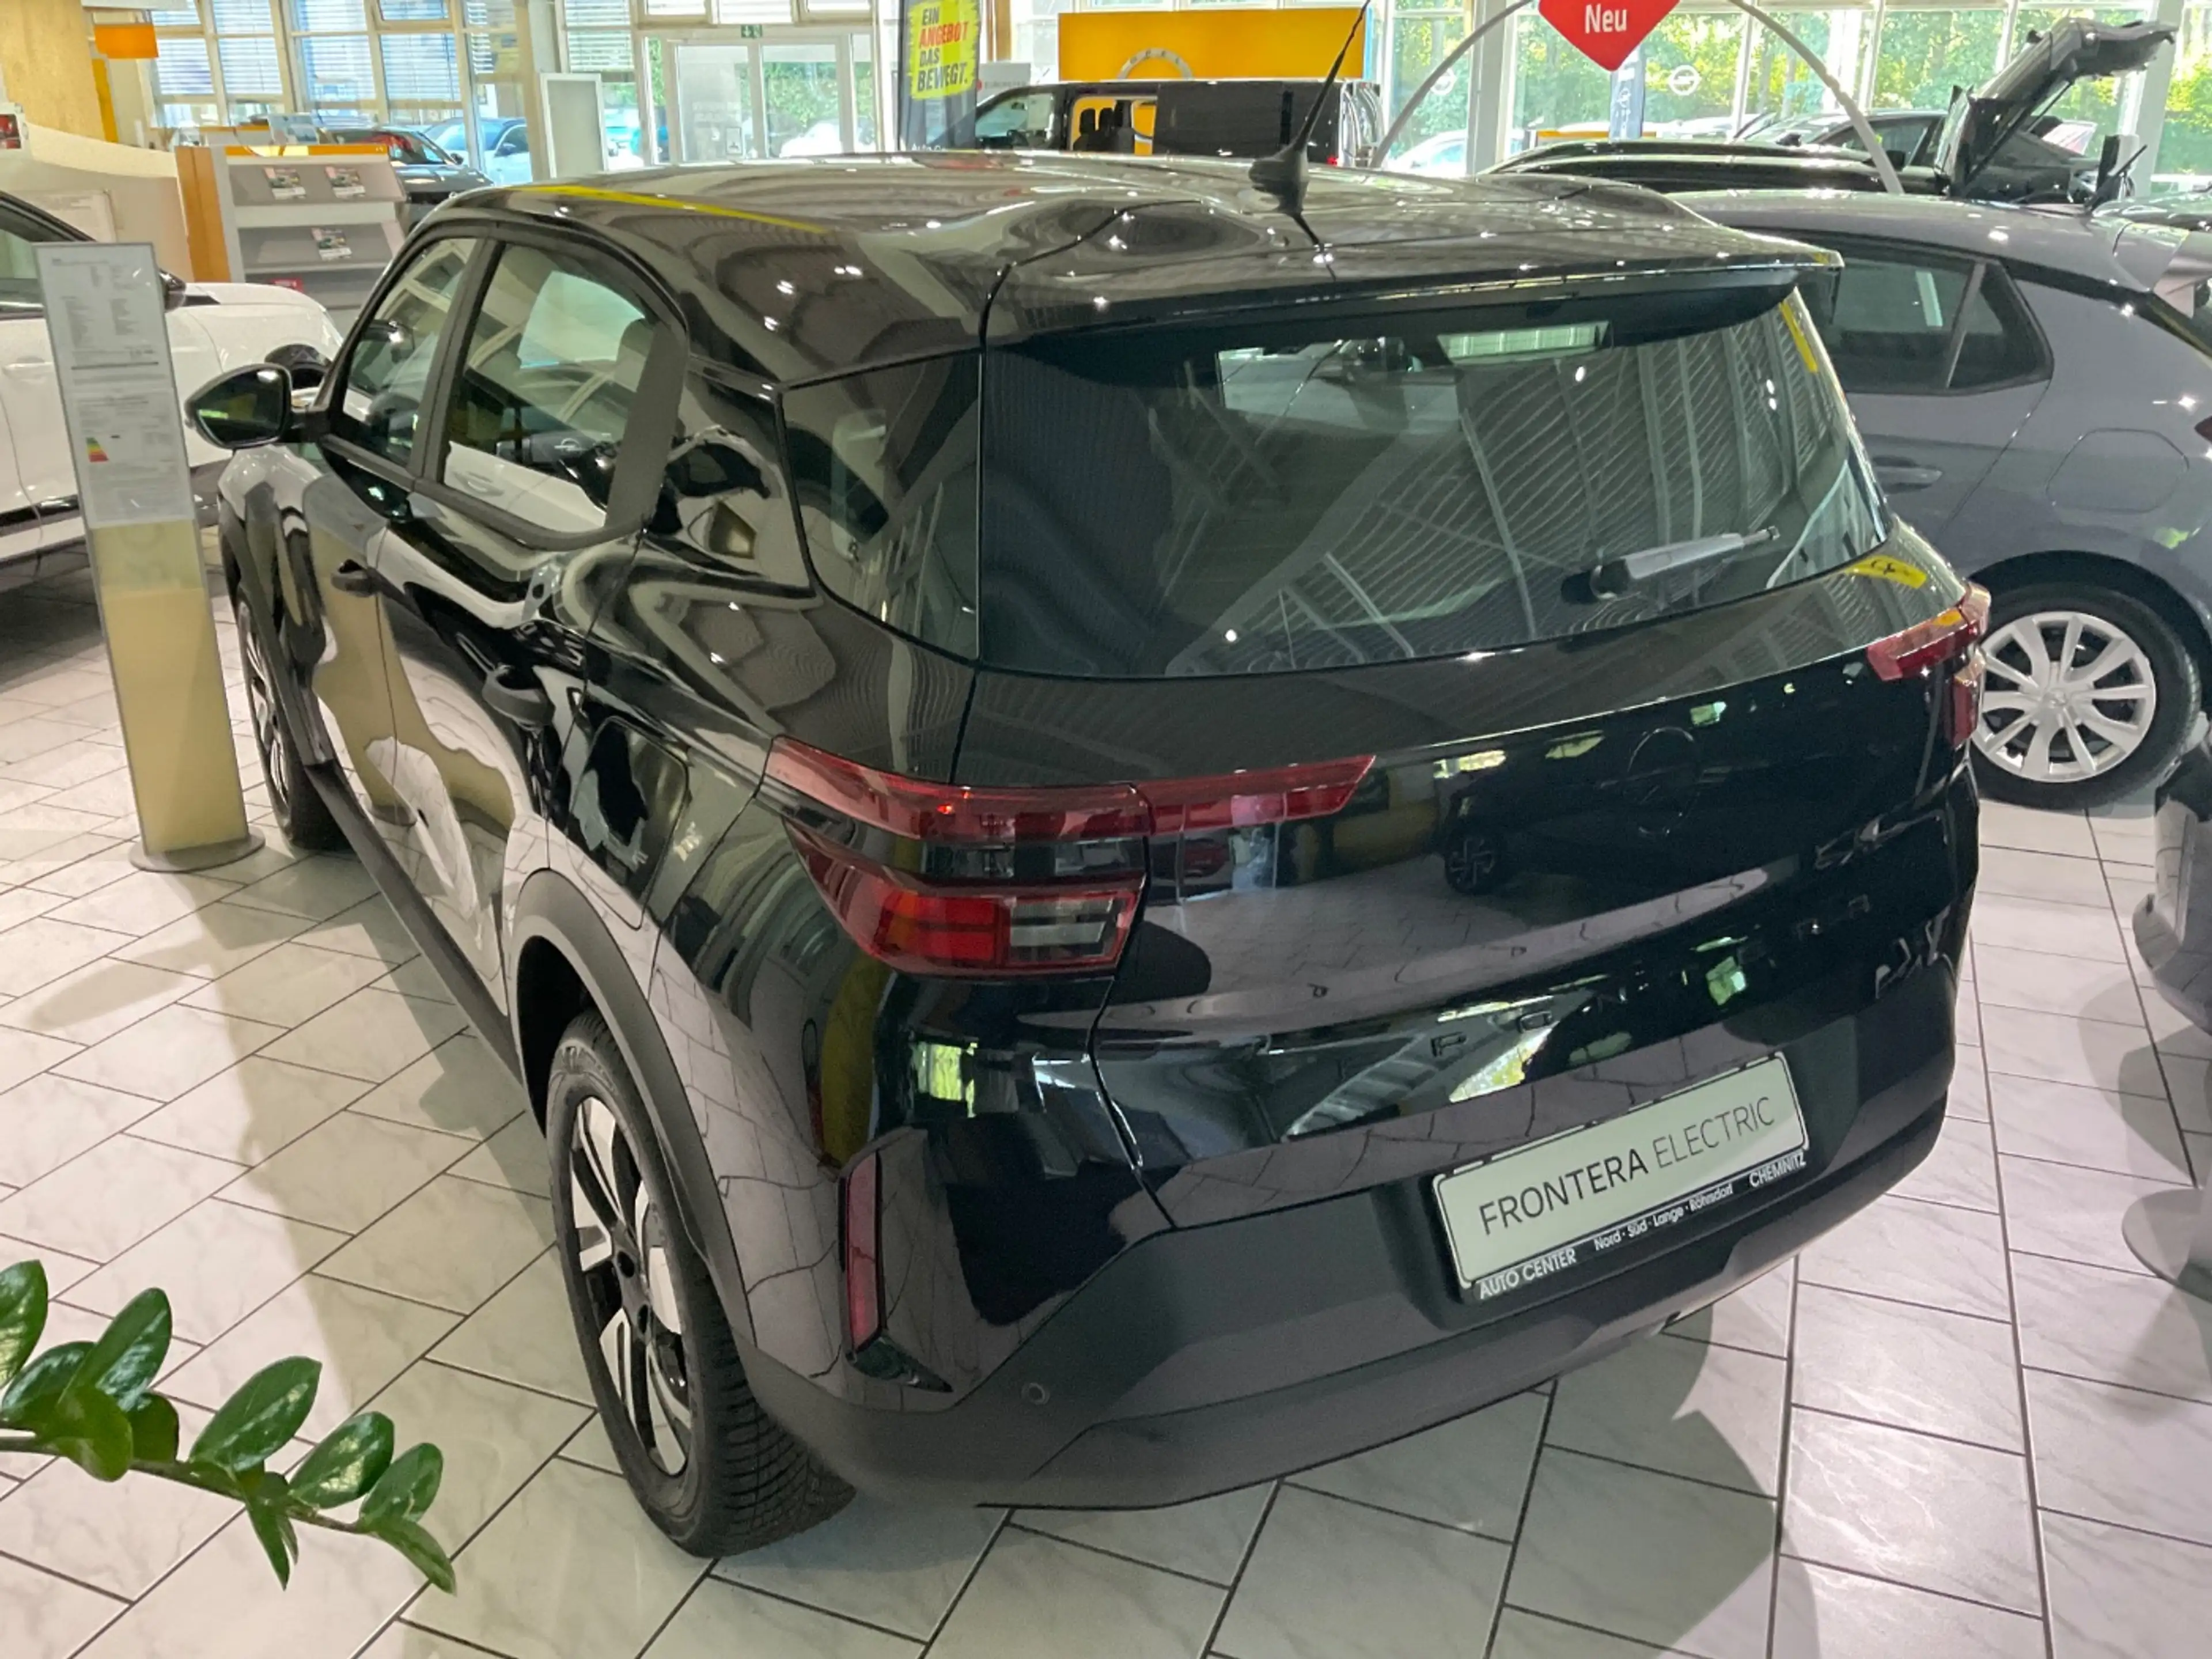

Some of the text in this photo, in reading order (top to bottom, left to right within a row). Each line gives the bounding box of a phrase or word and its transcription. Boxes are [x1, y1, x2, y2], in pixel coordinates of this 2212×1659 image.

[922, 6, 940, 25] EIN
[1585, 3, 1627, 34] Neu
[919, 21, 969, 48] ANGEBOT
[919, 47, 940, 67] DAS
[917, 62, 968, 92] BEWEGT.
[1478, 1096, 1775, 1236] FRONTERA ELECTRIC
[1479, 1270, 1520, 1300] AUTO
[1522, 1248, 1577, 1282] CENTER
[1593, 1227, 1622, 1251] Nord
[1627, 1218, 1649, 1238] Süd
[1653, 1206, 1684, 1228] Lange
[1749, 1150, 1806, 1188] CHEMNITZ
